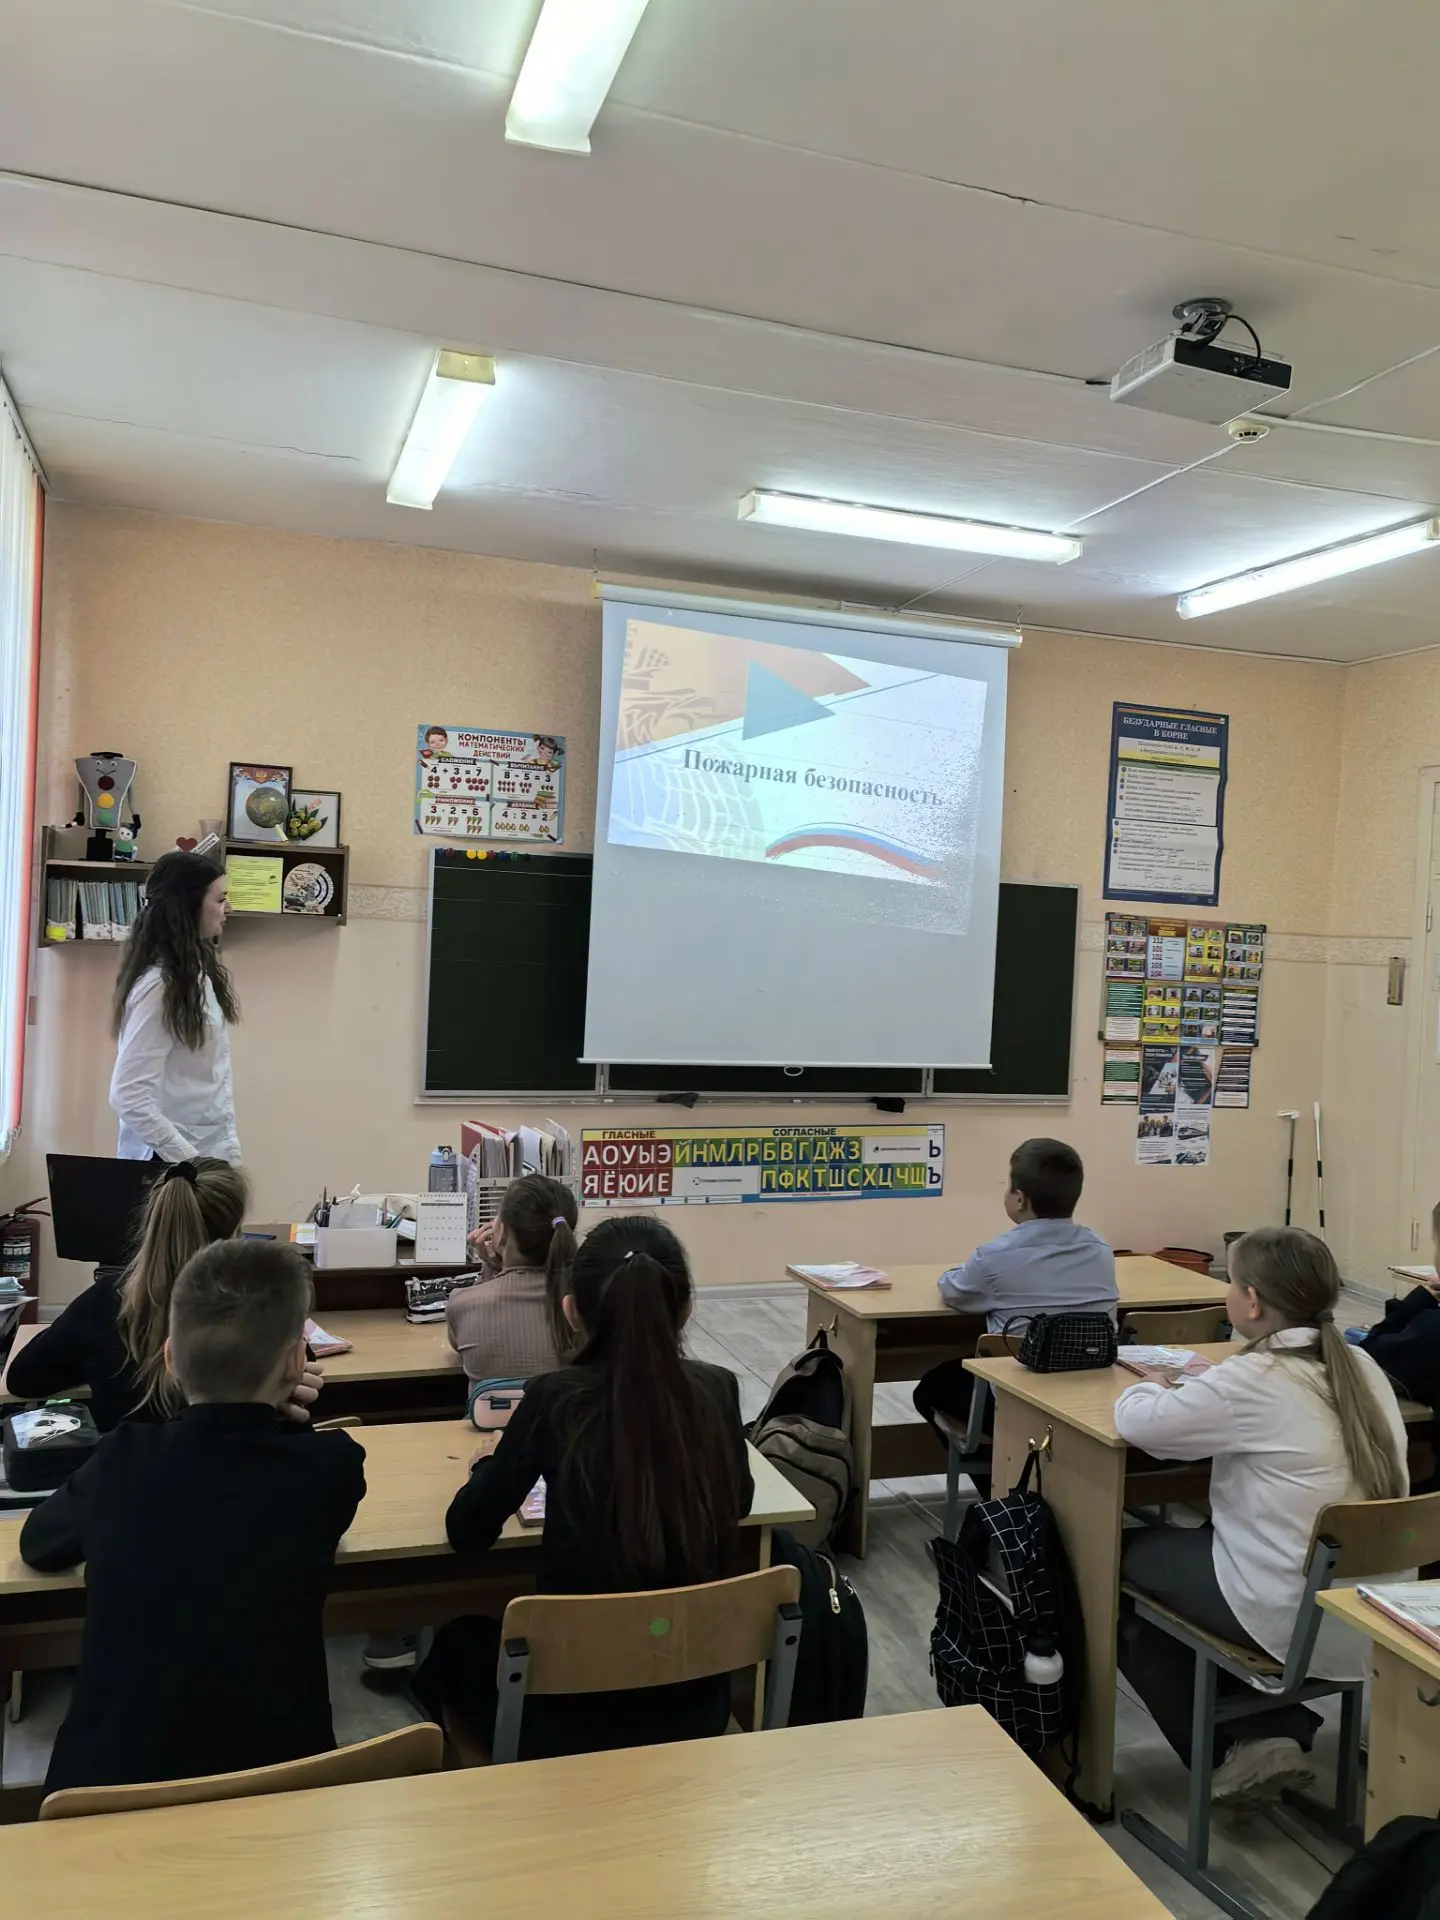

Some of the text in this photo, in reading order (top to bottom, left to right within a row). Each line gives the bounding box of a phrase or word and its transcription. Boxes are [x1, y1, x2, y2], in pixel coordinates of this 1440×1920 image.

[1123, 716, 1218, 734] БЕЗУДАРНЫЕ ГЛАСНЫЕ
[458, 732, 527, 746] КОМПОНЕНТЫ
[1153, 729, 1189, 740] В КОРНЕ
[459, 741, 525, 753] МАТЕМАТИЧЕСКИХ
[431, 766, 438, 774] 4
[453, 767, 460, 775] 3
[476, 768, 482, 777] 7
[504, 771, 510, 779] 8
[524, 772, 530, 780] 5
[544, 774, 551, 782] 3
[684, 749, 944, 807] Пожарная безопасность
[431, 805, 437, 814] 3
[450, 807, 456, 815] 2
[472, 808, 479, 816] 6
[521, 812, 527, 820] 2
[542, 813, 548, 821] 2
[602, 1130, 656, 1139] ГЛАСНЫЕ
[773, 1127, 837, 1136] СОГЛАСНЫЕ
